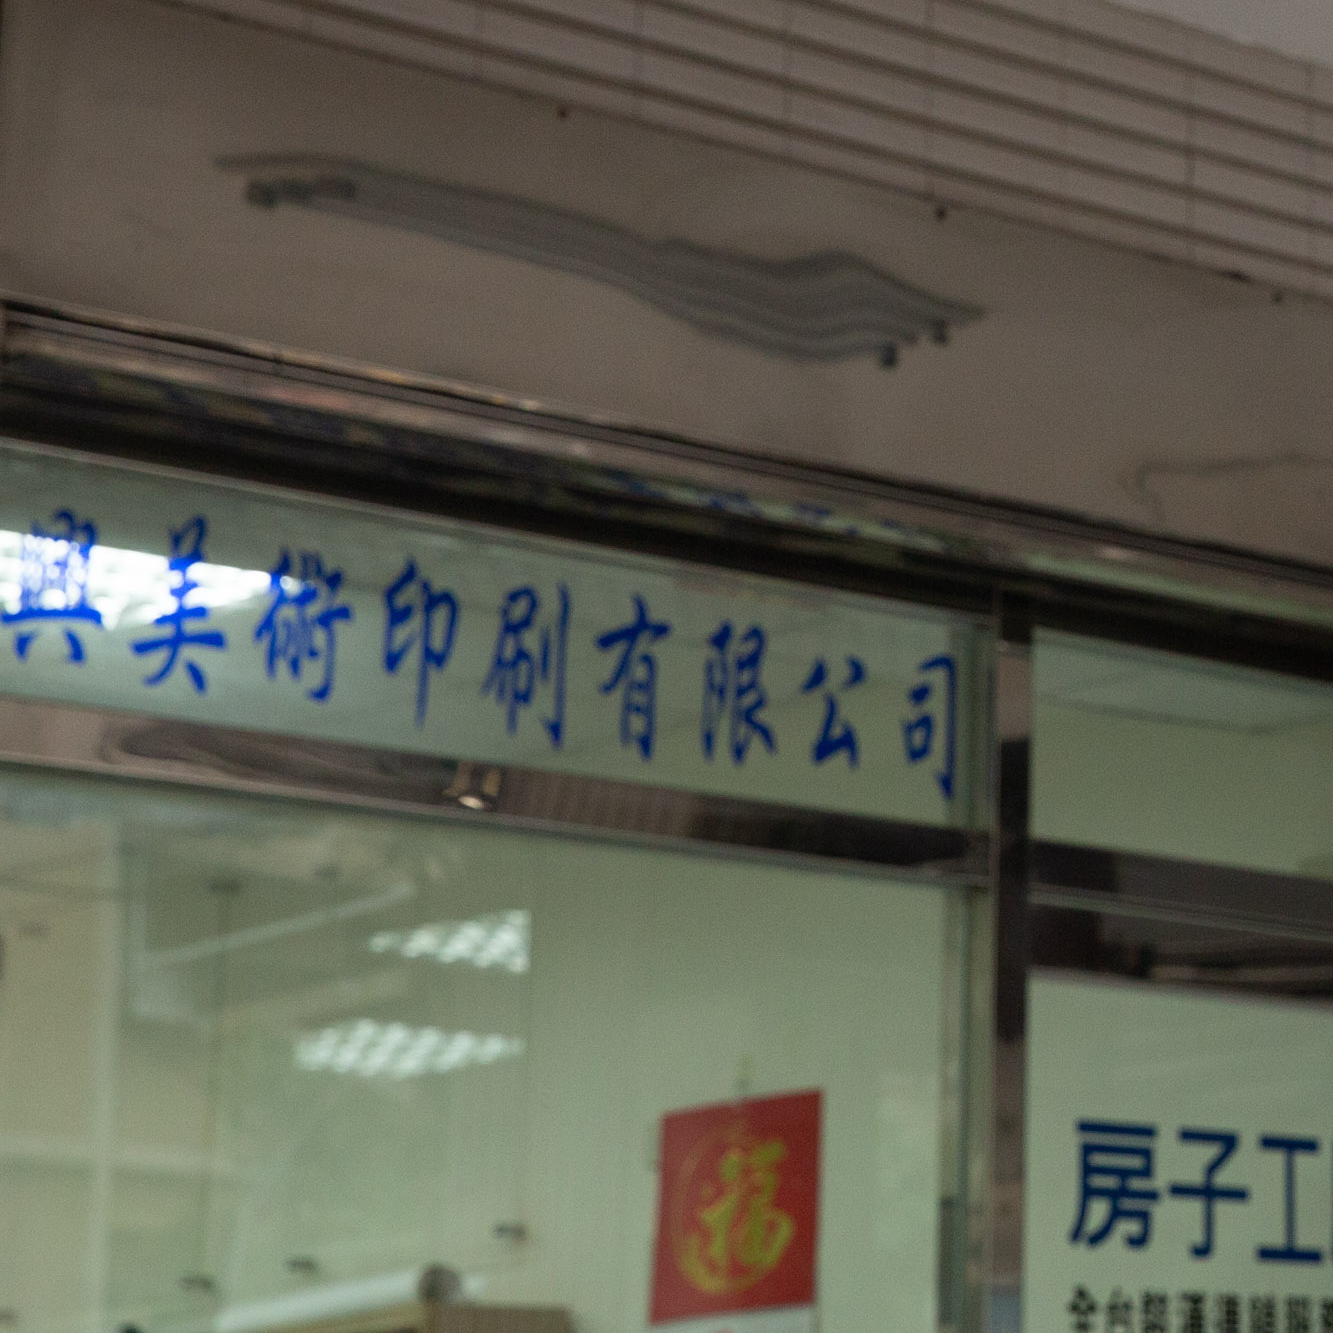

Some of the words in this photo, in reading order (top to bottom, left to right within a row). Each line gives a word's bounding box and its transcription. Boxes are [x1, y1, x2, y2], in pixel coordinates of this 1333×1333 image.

[0, 508, 958, 800] 興美術印刷有限公司
